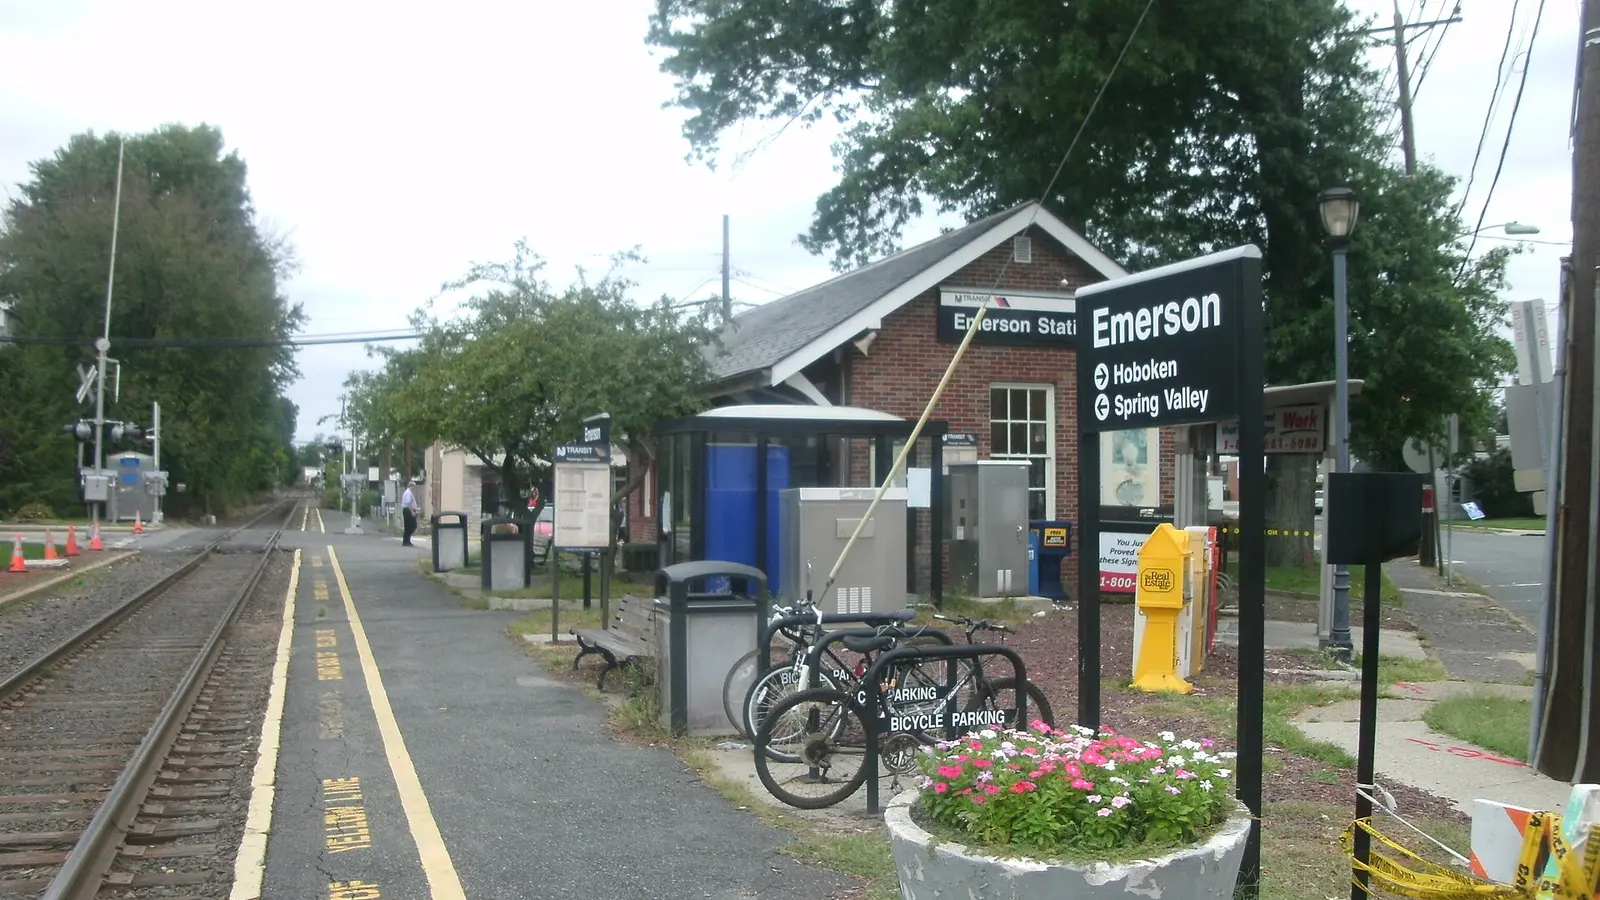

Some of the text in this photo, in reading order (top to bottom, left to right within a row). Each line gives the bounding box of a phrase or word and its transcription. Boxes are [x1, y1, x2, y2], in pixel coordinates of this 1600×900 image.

[1038, 317, 1077, 335] Stati
[1093, 292, 1221, 349] Emerson
[1113, 358, 1178, 385] Hoboken
[1114, 386, 1209, 420] Spring Valley
[1109, 547, 1136, 556] Proved
[1116, 538, 1130, 547] You
[1099, 557, 1139, 567] these Sign
[1144, 578, 1171, 588] Estate
[1151, 571, 1170, 581] Real
[890, 709, 1006, 732] BICYCLE PARKING
[322, 776, 363, 802] LINE
[324, 806, 372, 854] YELLOW
